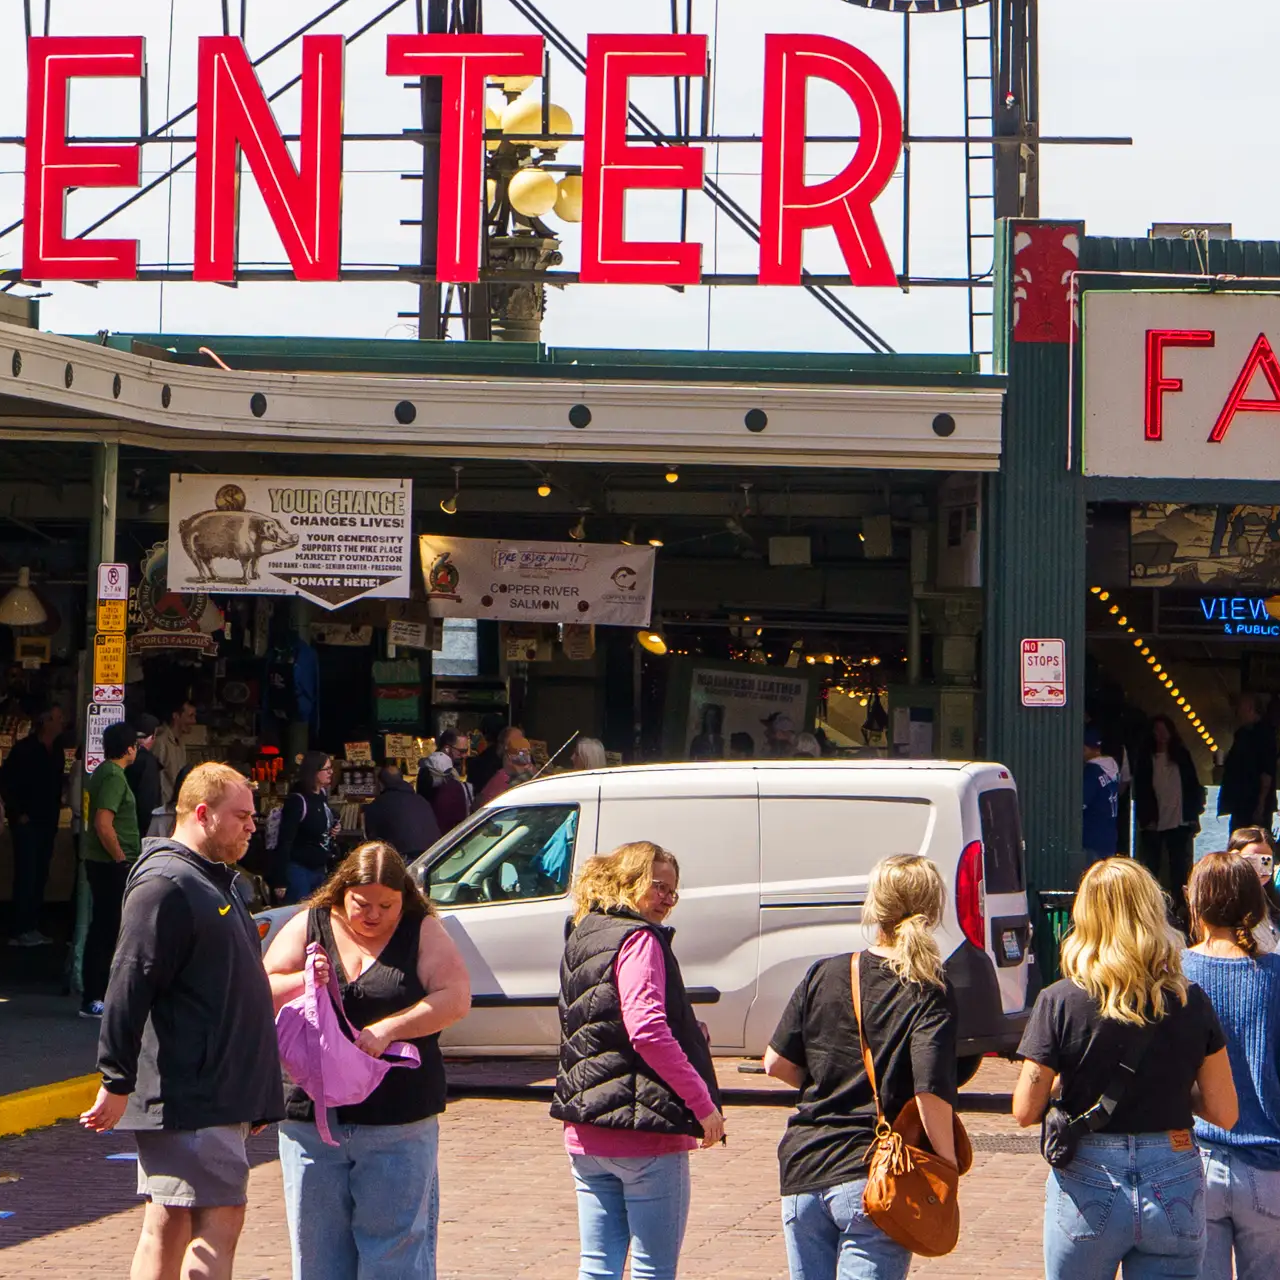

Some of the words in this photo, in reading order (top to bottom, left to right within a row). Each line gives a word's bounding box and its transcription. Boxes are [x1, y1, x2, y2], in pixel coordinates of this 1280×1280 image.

[268, 488, 322, 514] YOUR
[325, 489, 405, 516] CHANGE
[290, 516, 357, 527] CHANGES
[360, 517, 404, 528] LIVES!
[307, 533, 335, 542] YOUR
[337, 534, 404, 543] GENEROSITY
[301, 544, 342, 552] SUPPORTS
[344, 544, 358, 553] THE
[360, 545, 377, 553] PIKE
[379, 545, 403, 554] PLACE
[295, 553, 337, 562] MARKET
[339, 554, 402, 563] FOUNDATION
[291, 577, 340, 587] DONATE
[343, 578, 380, 587] HERE!
[543, 584, 580, 597] RIVER
[1224, 623, 1232, 634] &
[1237, 624, 1280, 636] PUBLIC
[170, 637, 210, 646] FAMOUS
[1024, 642, 1036, 651] NO
[1028, 656, 1059, 666] STOPS
[91, 706, 98, 714] 3
